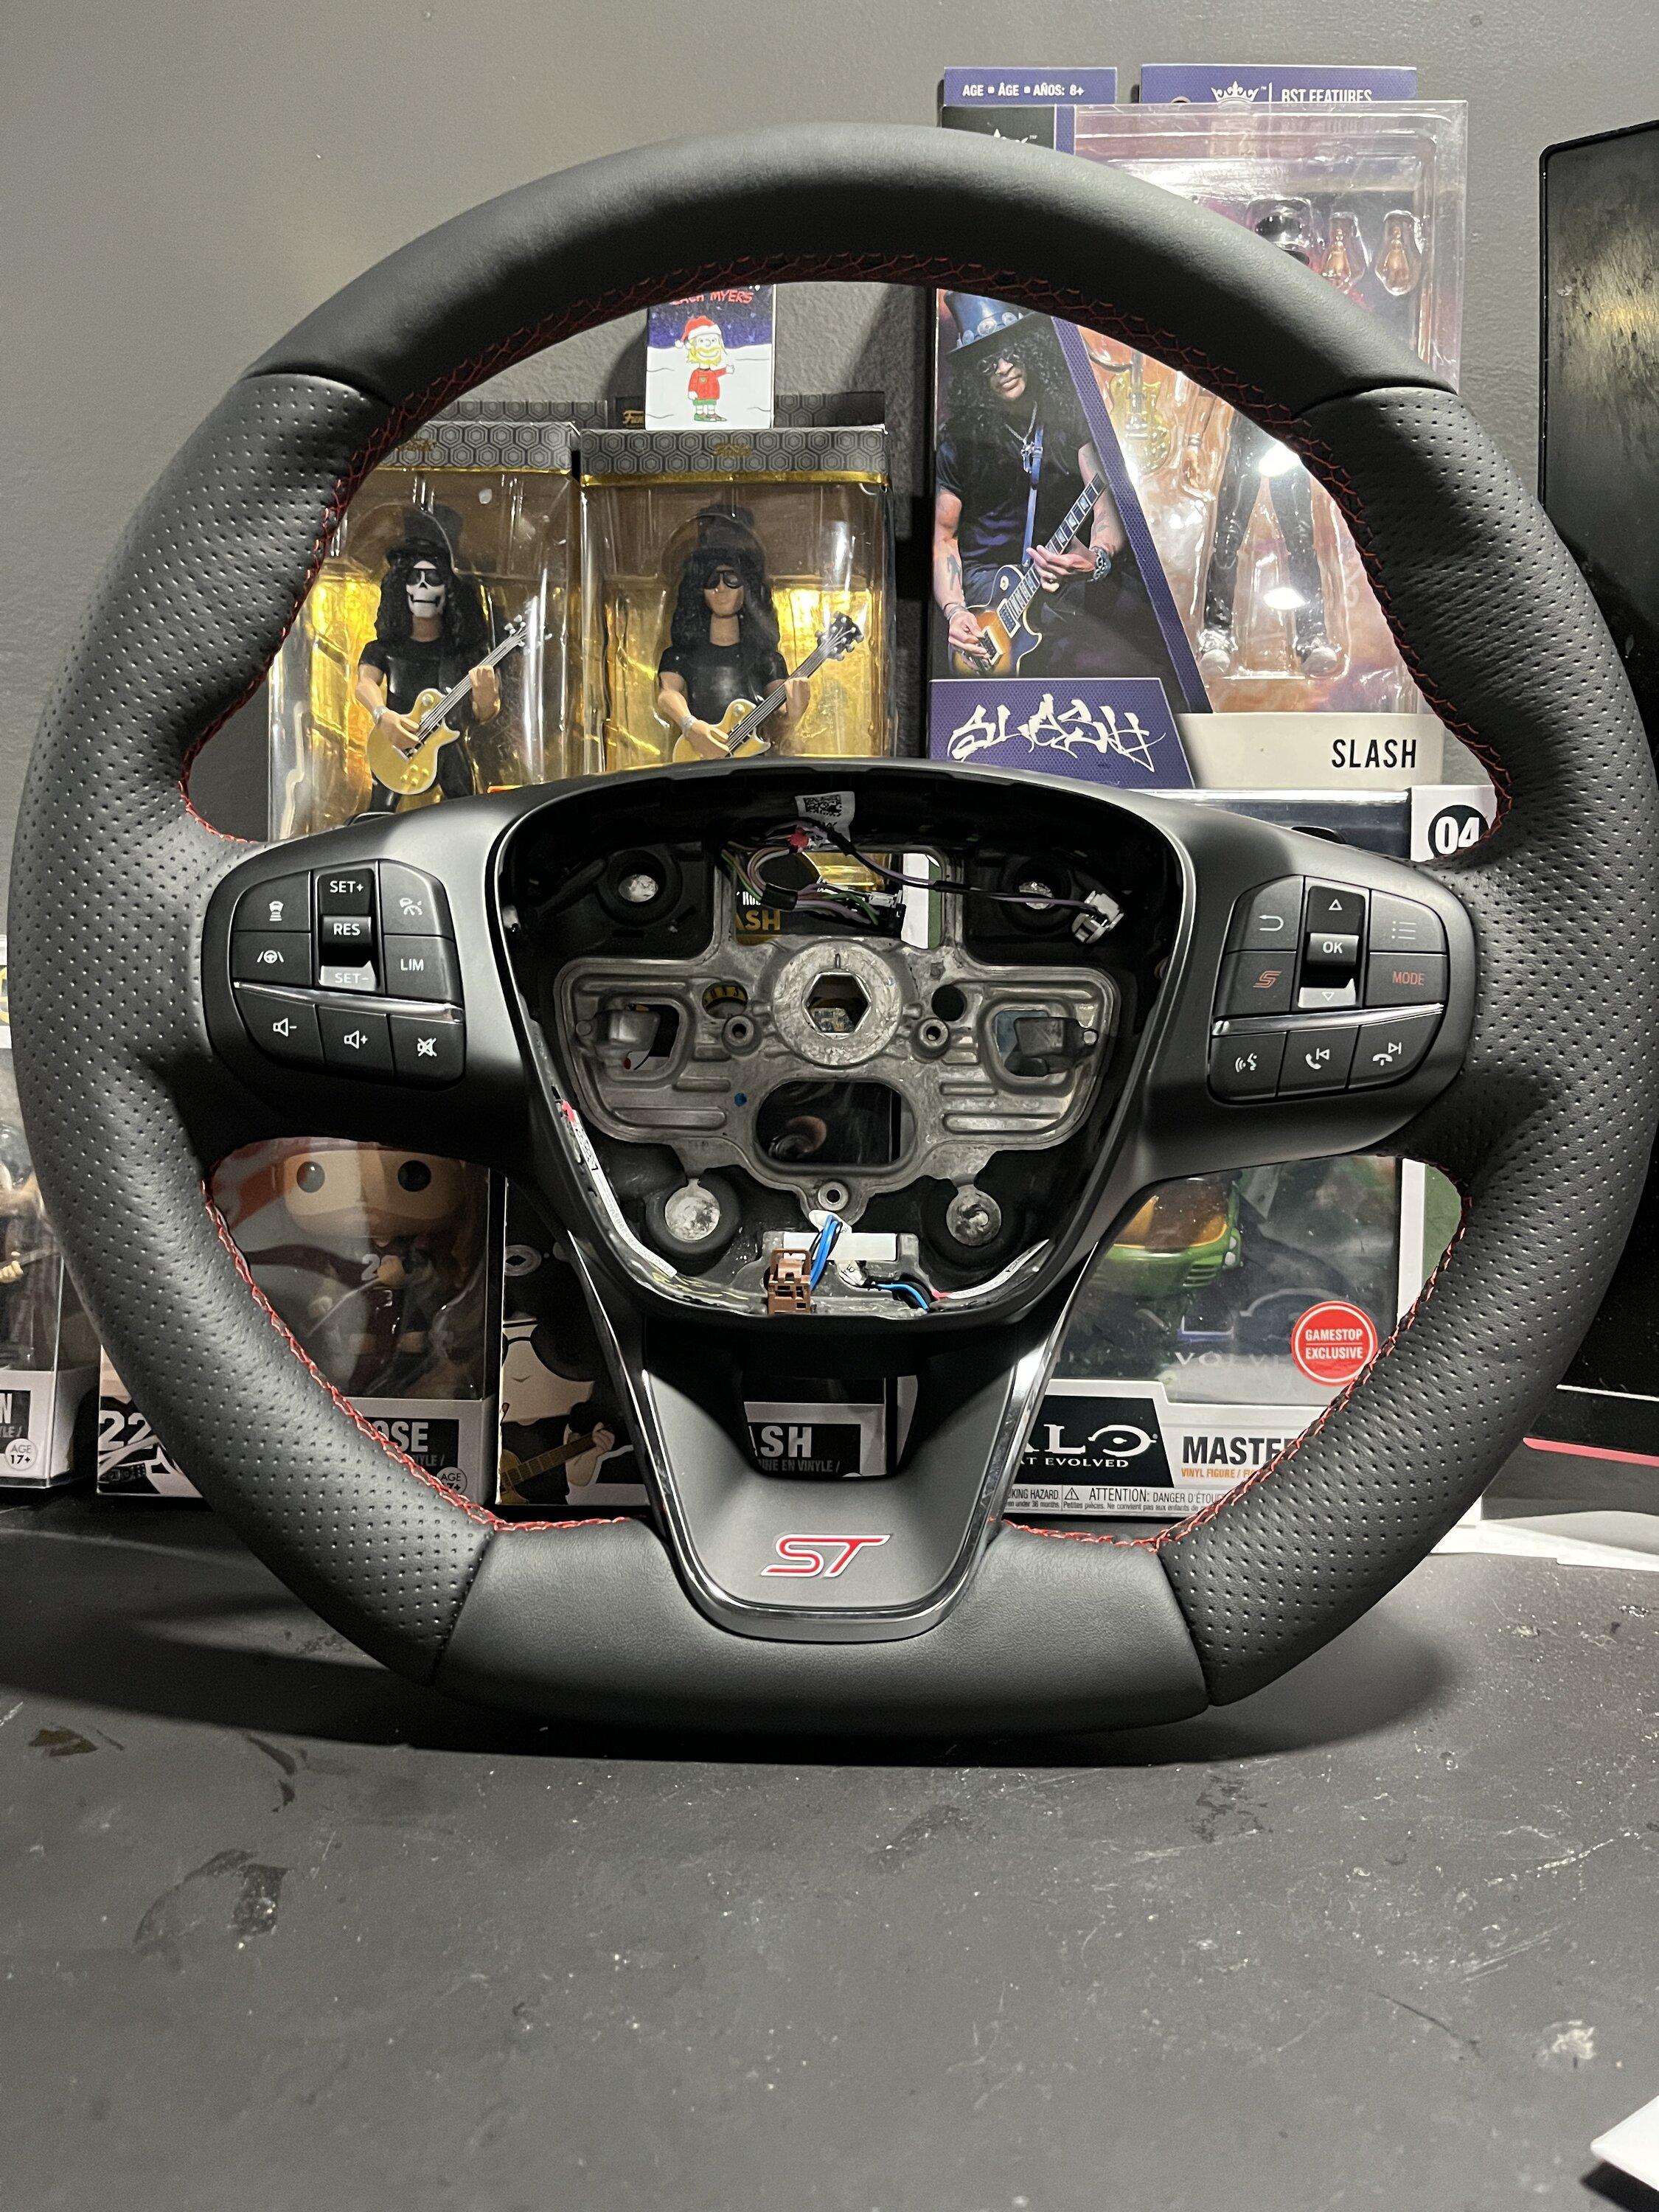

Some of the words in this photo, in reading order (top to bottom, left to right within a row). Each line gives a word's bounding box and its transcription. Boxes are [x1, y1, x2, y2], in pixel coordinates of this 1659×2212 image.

[962, 84, 984, 97] AGE
[998, 82, 1020, 97] ÂGE
[1033, 83, 1065, 97] AÑOS:
[1069, 84, 1085, 96] 8+
[709, 289, 754, 304] MYERS
[1331, 739, 1417, 768] SLASH
[1435, 815, 1480, 855] 04
[330, 880, 364, 893] SET+
[333, 923, 361, 936] RES
[1322, 940, 1343, 954] OK
[400, 959, 425, 971] LIM
[1392, 972, 1425, 985] MODE
[1305, 1329, 1363, 1341] GAMESTOP
[1305, 1346, 1363, 1360] EXCLUSIVE
[748, 1425, 812, 1458] SH
[12, 1445, 31, 1453] AGE
[1183, 1436, 1296, 1464] MASTE
[11, 1455, 31, 1464] 17+
[798, 1459, 833, 1472] VINYLE
[1046, 1458, 1129, 1468] EVOLVED
[441, 1473, 462, 1481] AGE
[1181, 1468, 1203, 1478] VINYL
[1206, 1469, 1234, 1478] FIGURE
[1089, 1487, 1150, 1502] ATTENTION:
[1153, 1492, 1186, 1503] DANGER
[761, 1534, 891, 1577] ST
